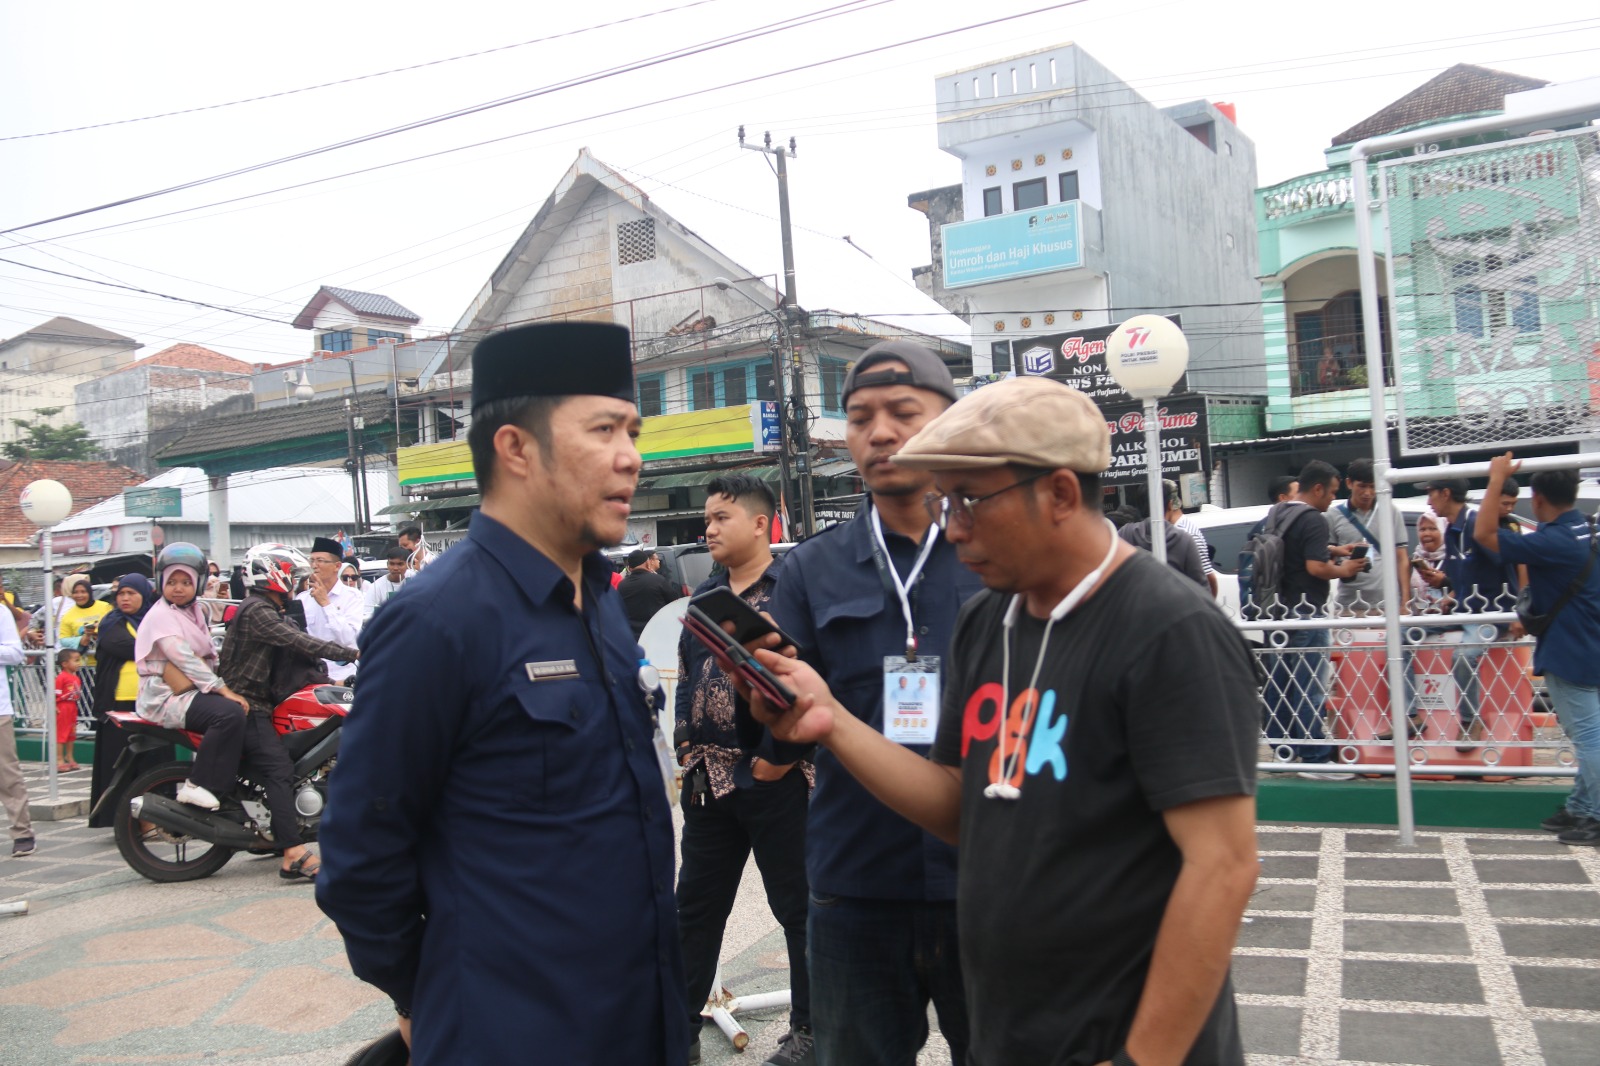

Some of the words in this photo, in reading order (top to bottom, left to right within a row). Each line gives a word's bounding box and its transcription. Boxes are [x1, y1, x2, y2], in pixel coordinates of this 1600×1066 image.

[949, 253, 984, 269] Umroh
[986, 251, 1006, 264] dan
[1008, 244, 1030, 260] Haji
[1033, 239, 1073, 255] Khusus
[1061, 336, 1106, 363] Agen
[1073, 364, 1102, 375] NON
[1066, 376, 1092, 389] WS
[1097, 387, 1120, 397] Parfume
[841, 511, 856, 519] TASTE
